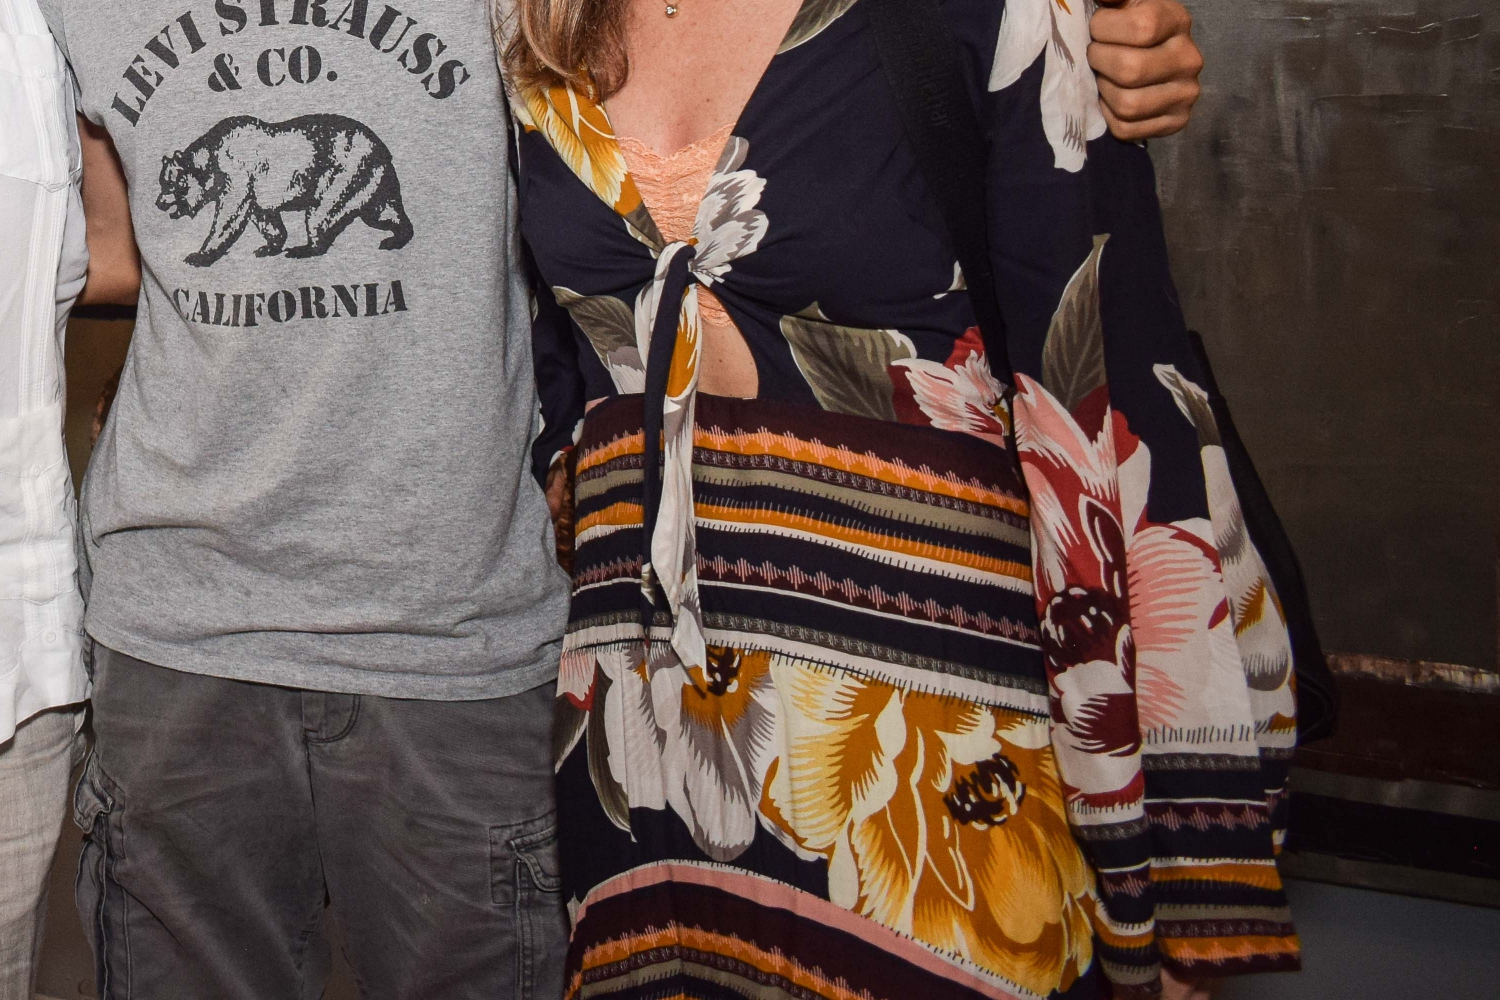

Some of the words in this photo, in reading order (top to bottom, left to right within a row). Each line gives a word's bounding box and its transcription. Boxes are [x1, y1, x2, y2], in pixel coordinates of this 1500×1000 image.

[111, 10, 207, 127] LEVI
[207, 53, 243, 93] &
[256, 45, 338, 87] CO.
[172, 279, 409, 328] CALIFORNIA
